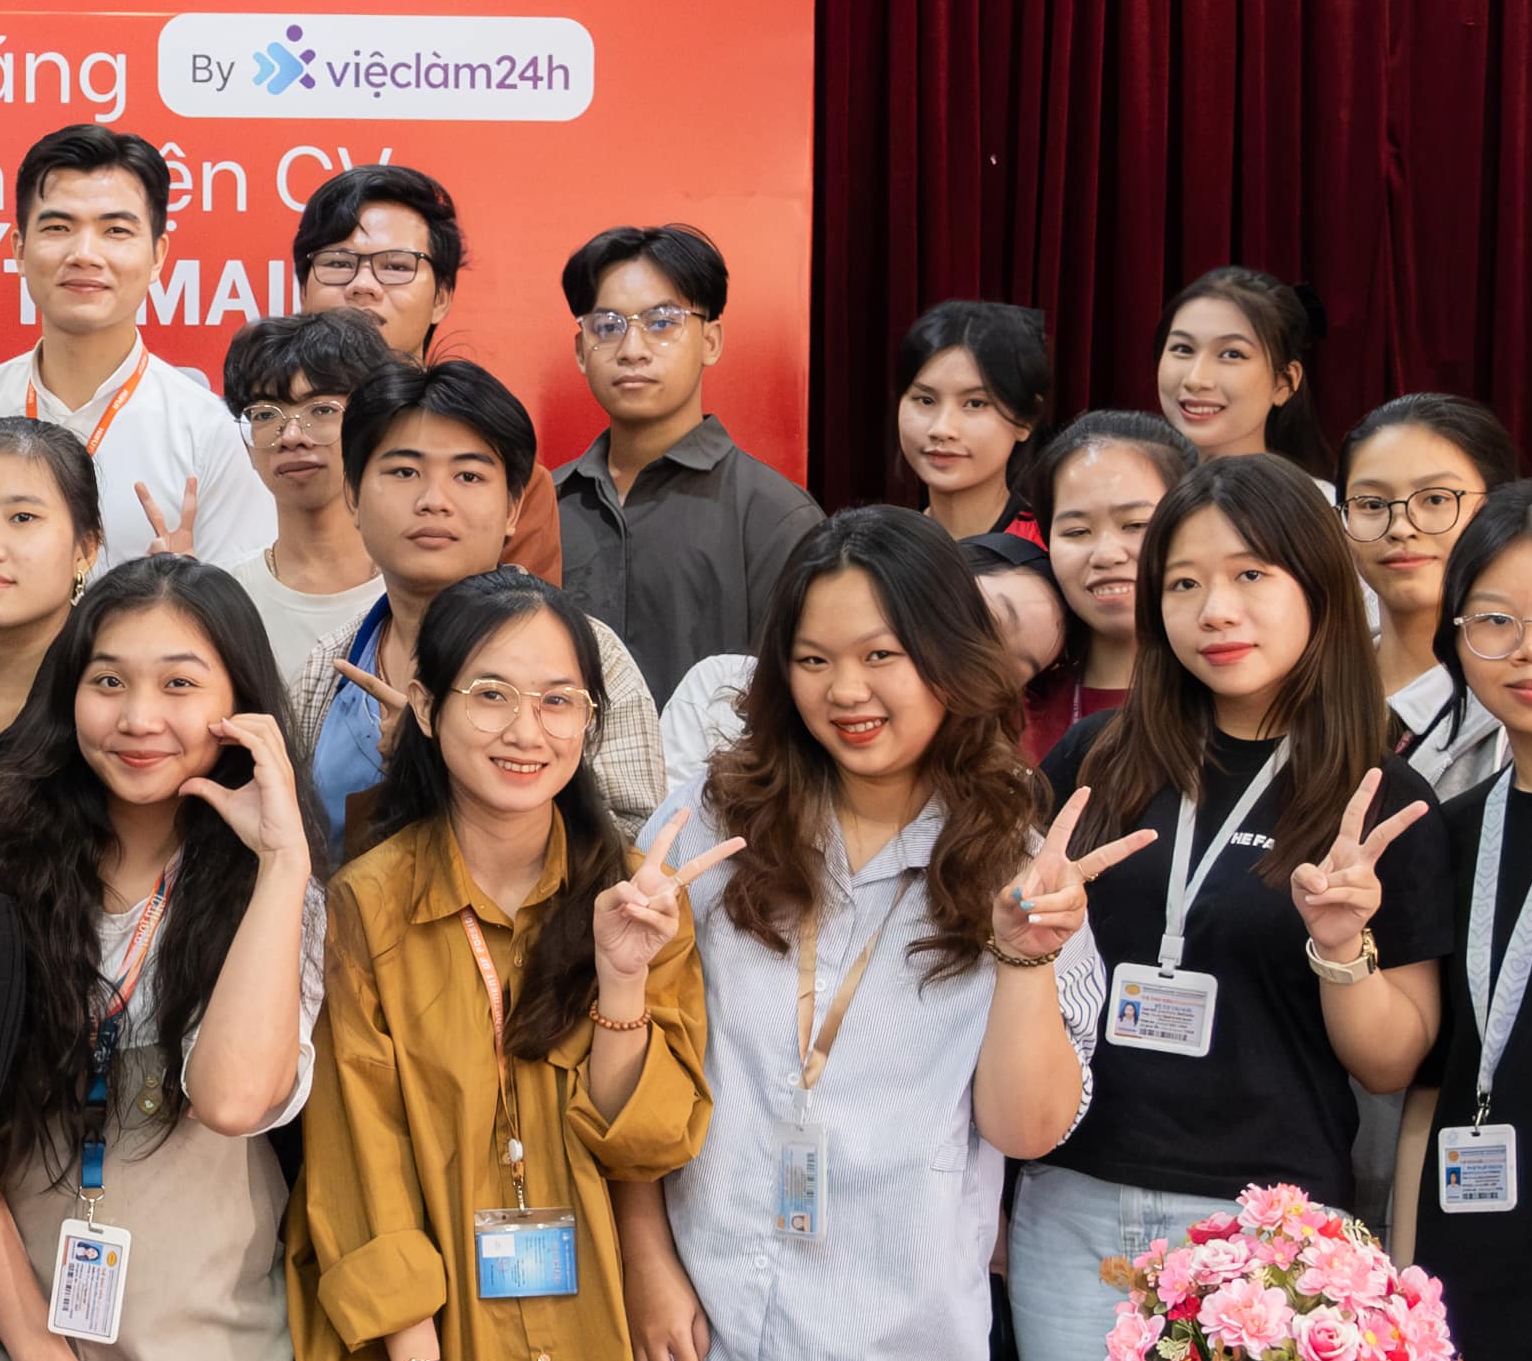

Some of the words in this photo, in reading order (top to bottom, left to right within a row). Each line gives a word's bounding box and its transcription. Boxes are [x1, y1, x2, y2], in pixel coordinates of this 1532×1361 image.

[191, 53, 236, 92] By
[327, 52, 570, 99] việclàm24h
[166, 143, 247, 232] ện
